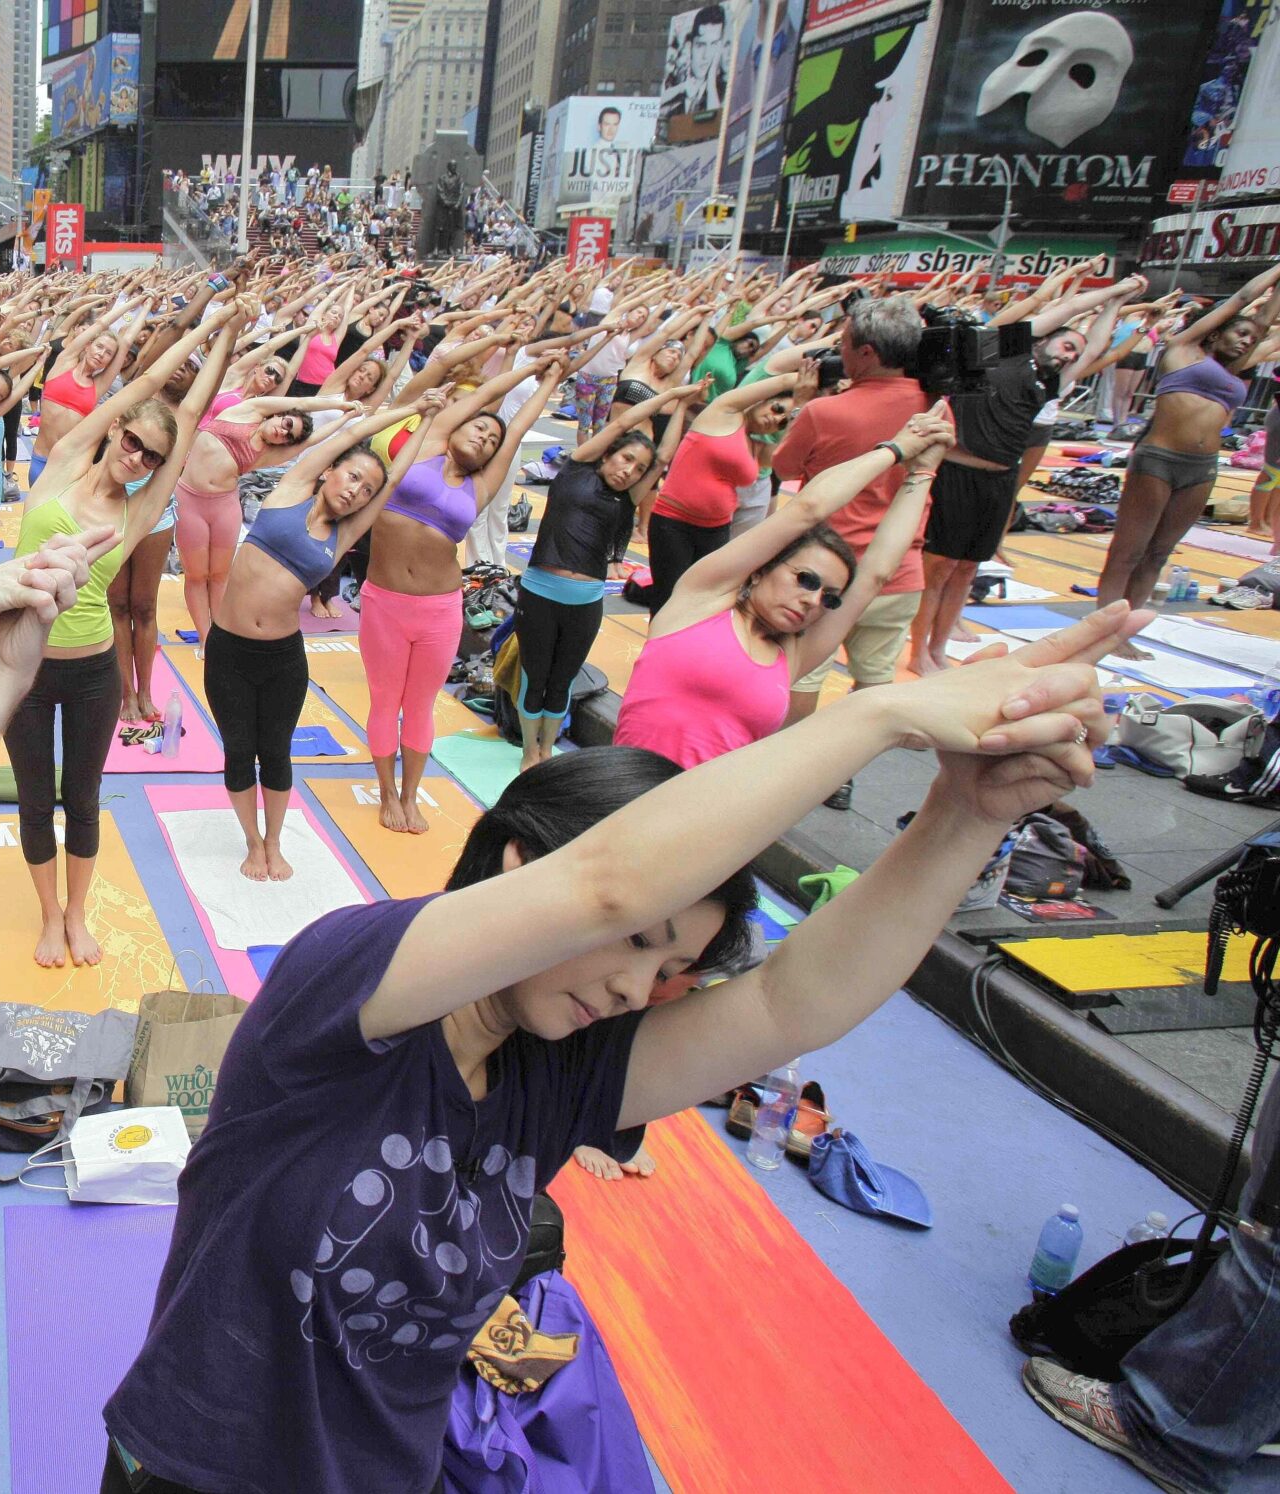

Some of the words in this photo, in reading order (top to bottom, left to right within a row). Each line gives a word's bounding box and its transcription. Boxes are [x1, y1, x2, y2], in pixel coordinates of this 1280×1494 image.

[201, 153, 297, 185] WHY
[914, 153, 1157, 189] PHANTOM
[1218, 167, 1268, 192] UNDAYS
[568, 180, 591, 193] WITH
[592, 181, 599, 191] A
[55, 208, 79, 255] tkts
[823, 250, 860, 274] sbarro
[164, 1063, 217, 1092] WHOL
[166, 1087, 215, 1108] FOOD
